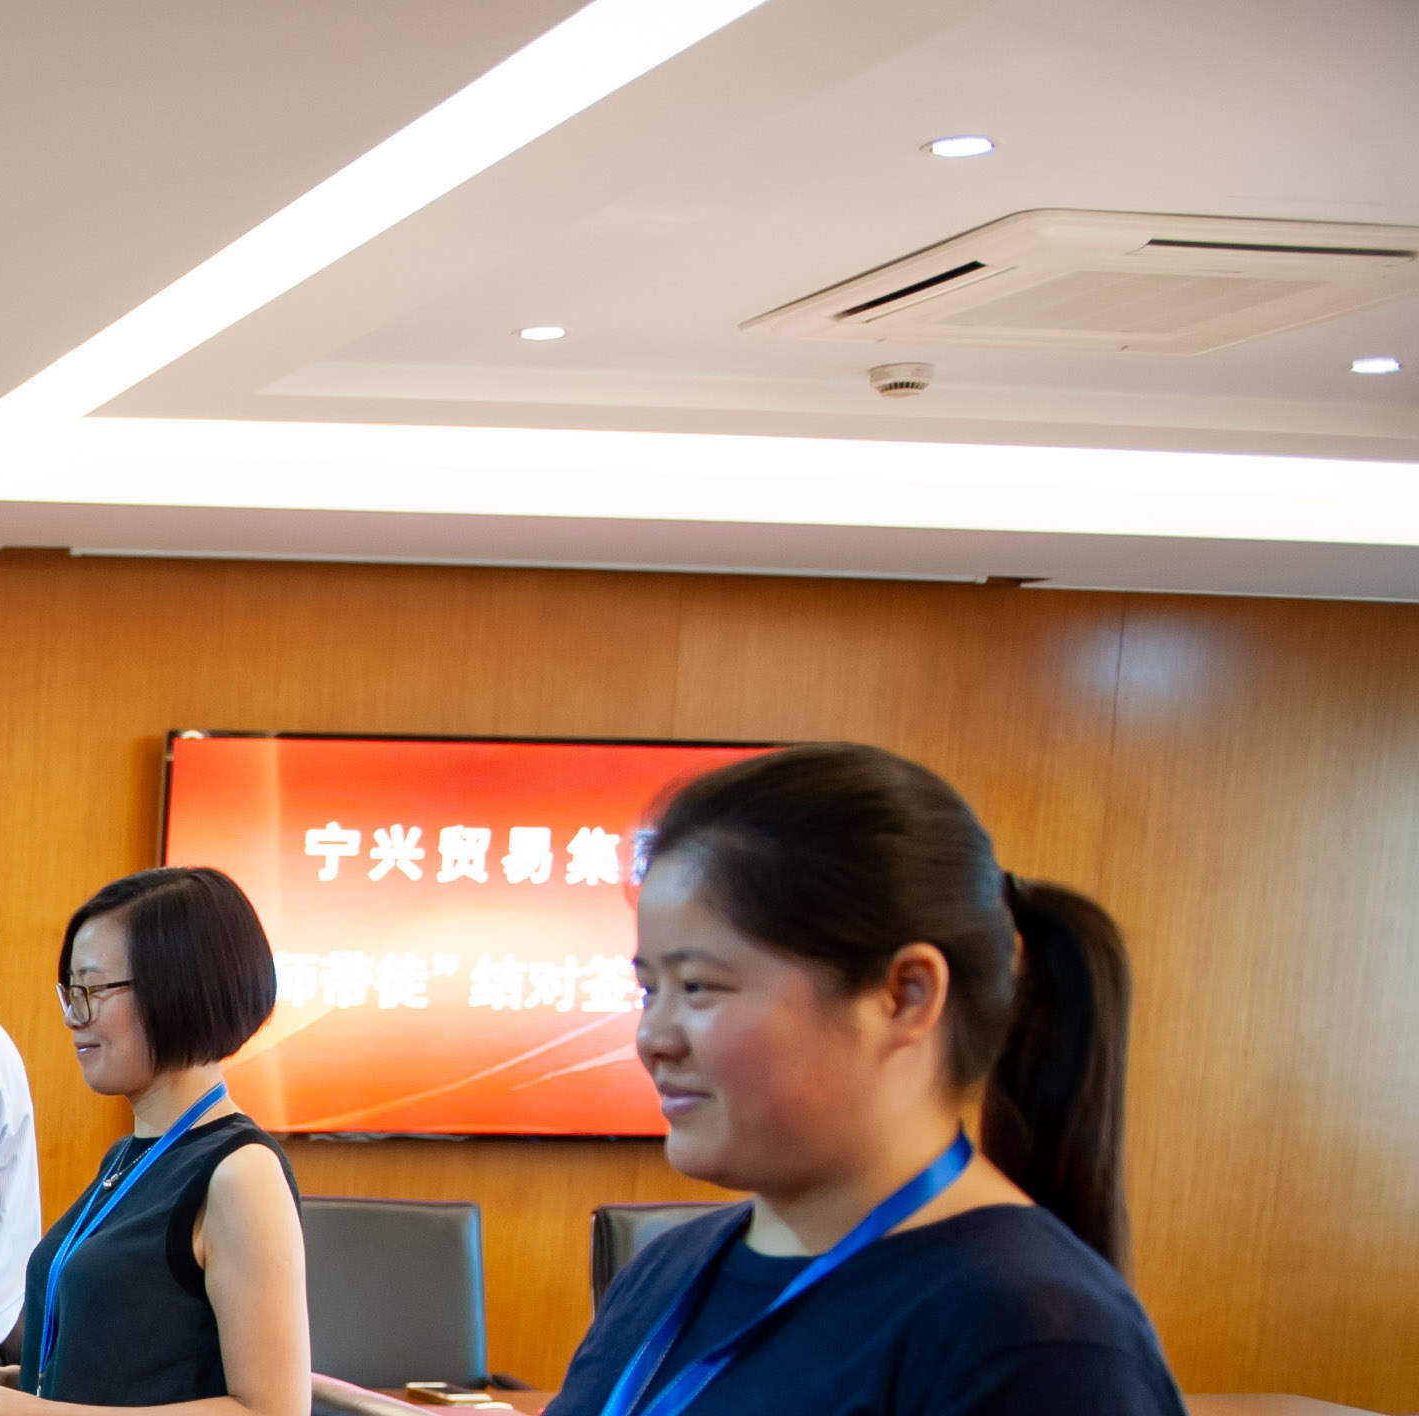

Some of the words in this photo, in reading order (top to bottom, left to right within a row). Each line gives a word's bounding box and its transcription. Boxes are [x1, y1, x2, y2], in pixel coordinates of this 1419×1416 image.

[305, 821, 656, 885] 宁兴贸易集
[273, 950, 646, 1014] 师带徒”结对签
